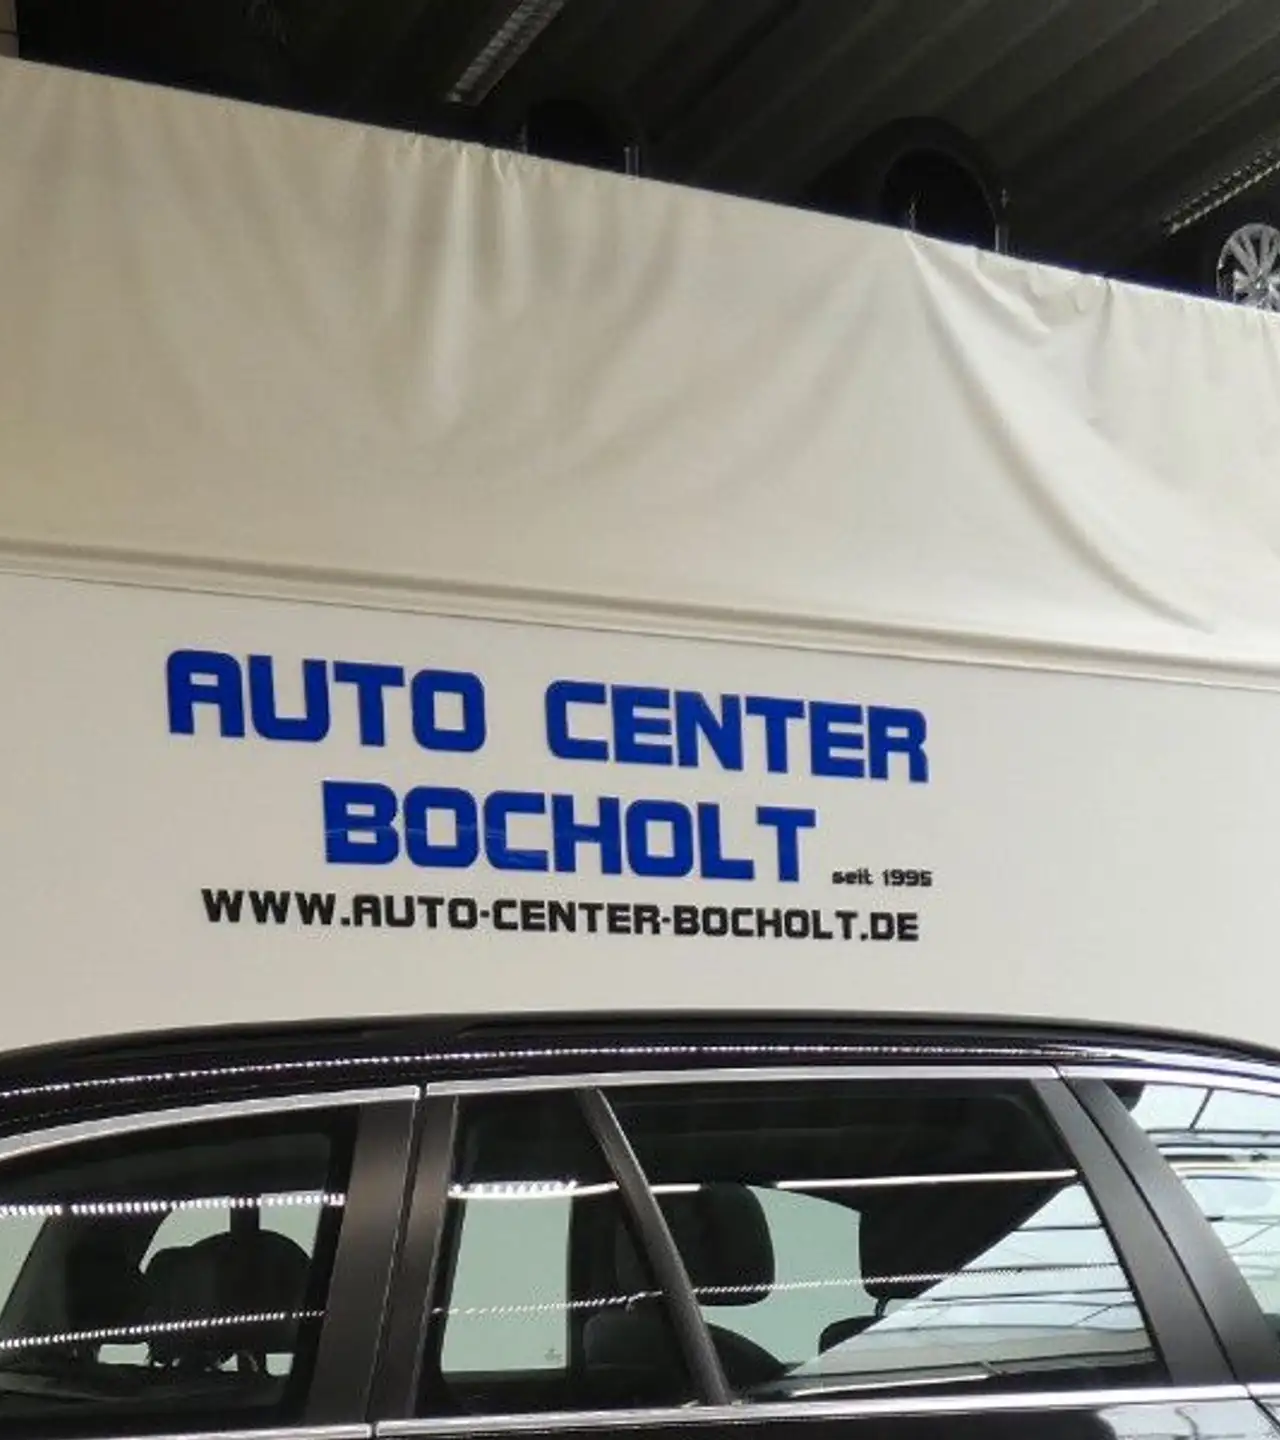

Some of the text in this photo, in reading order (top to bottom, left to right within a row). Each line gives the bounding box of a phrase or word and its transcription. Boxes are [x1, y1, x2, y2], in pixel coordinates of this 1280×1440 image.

[166, 649, 929, 783] AUTO CENTER
[321, 779, 933, 888] BOCHOLT seit 1995
[200, 887, 920, 943] WWW.AUTO-CENTER-BOCHOLT.DE
